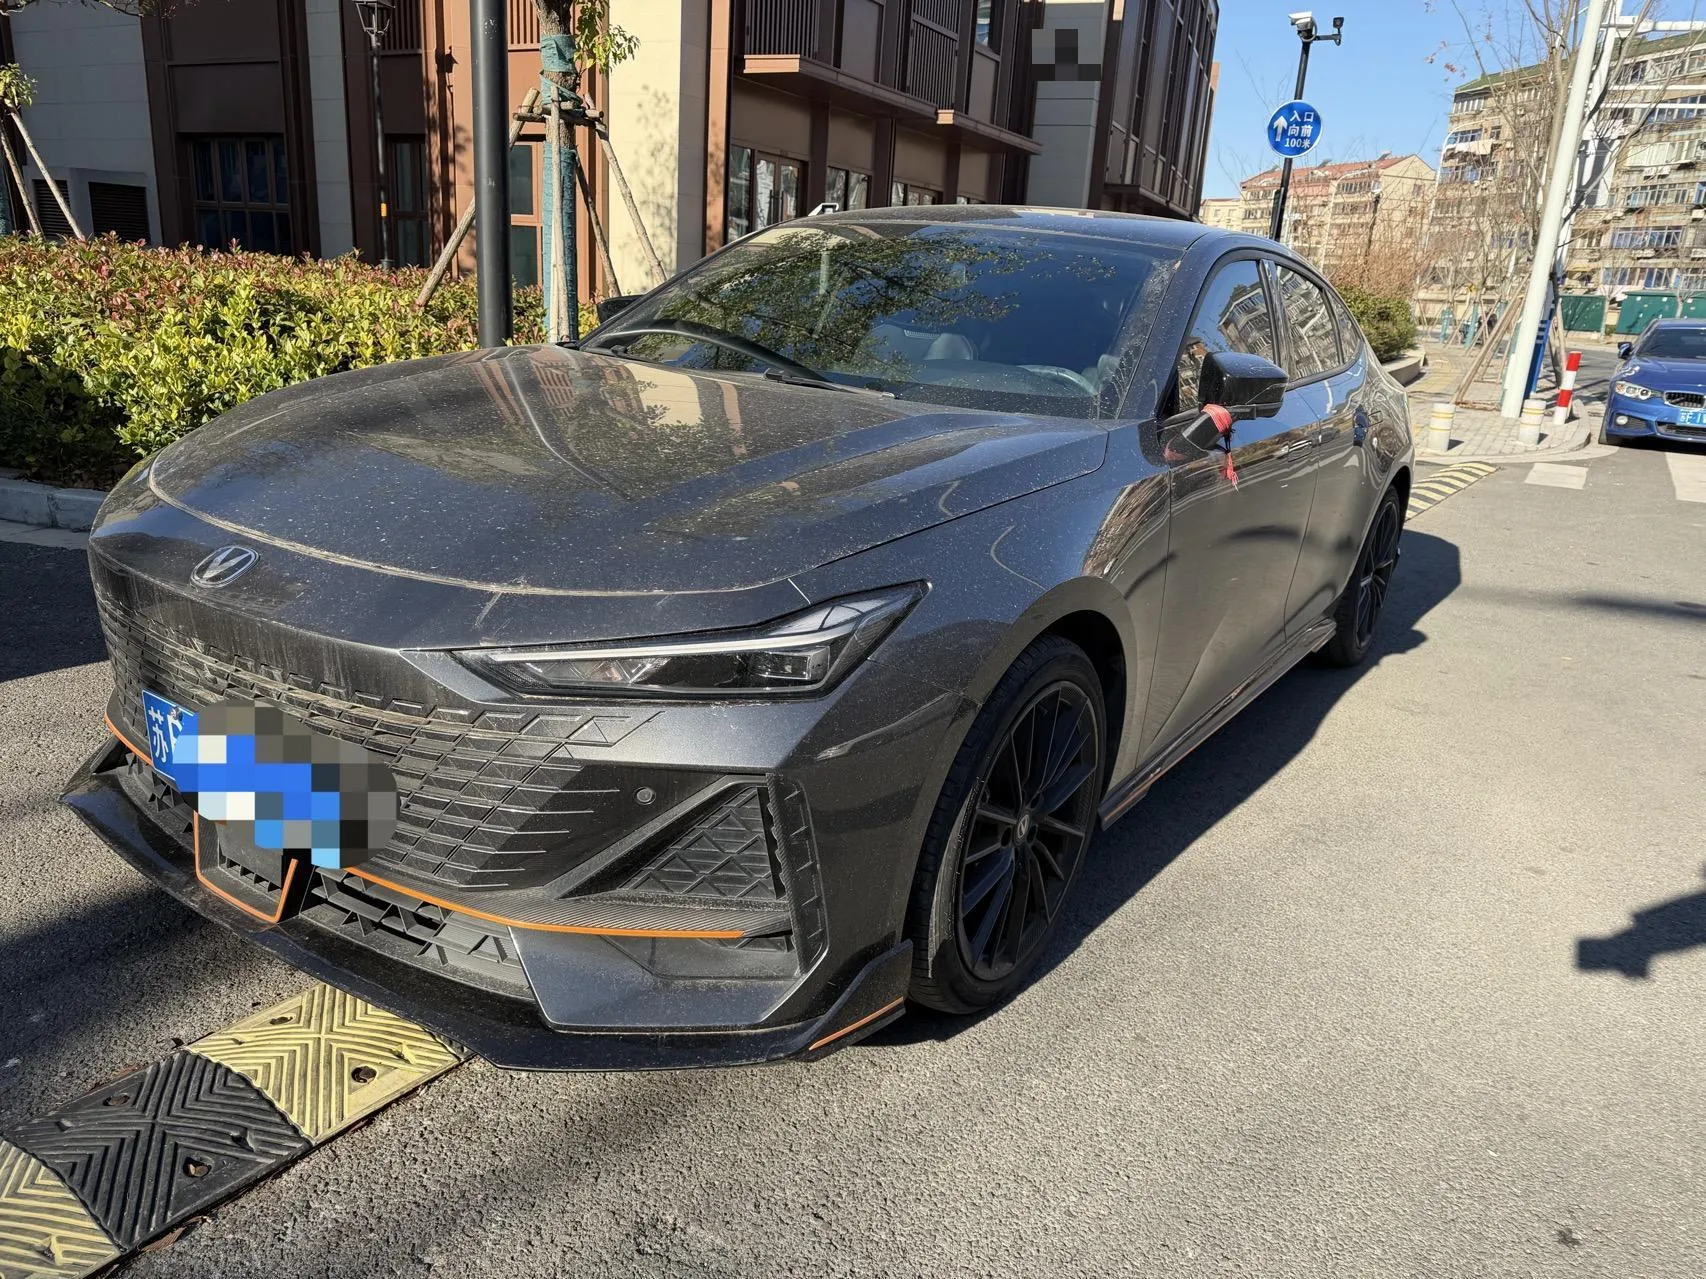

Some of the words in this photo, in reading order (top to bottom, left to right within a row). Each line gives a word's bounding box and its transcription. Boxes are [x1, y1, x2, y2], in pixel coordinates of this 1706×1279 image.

[1290, 110, 1314, 122] 入口
[1288, 124, 1313, 137] 向前
[1284, 138, 1311, 149] 100米
